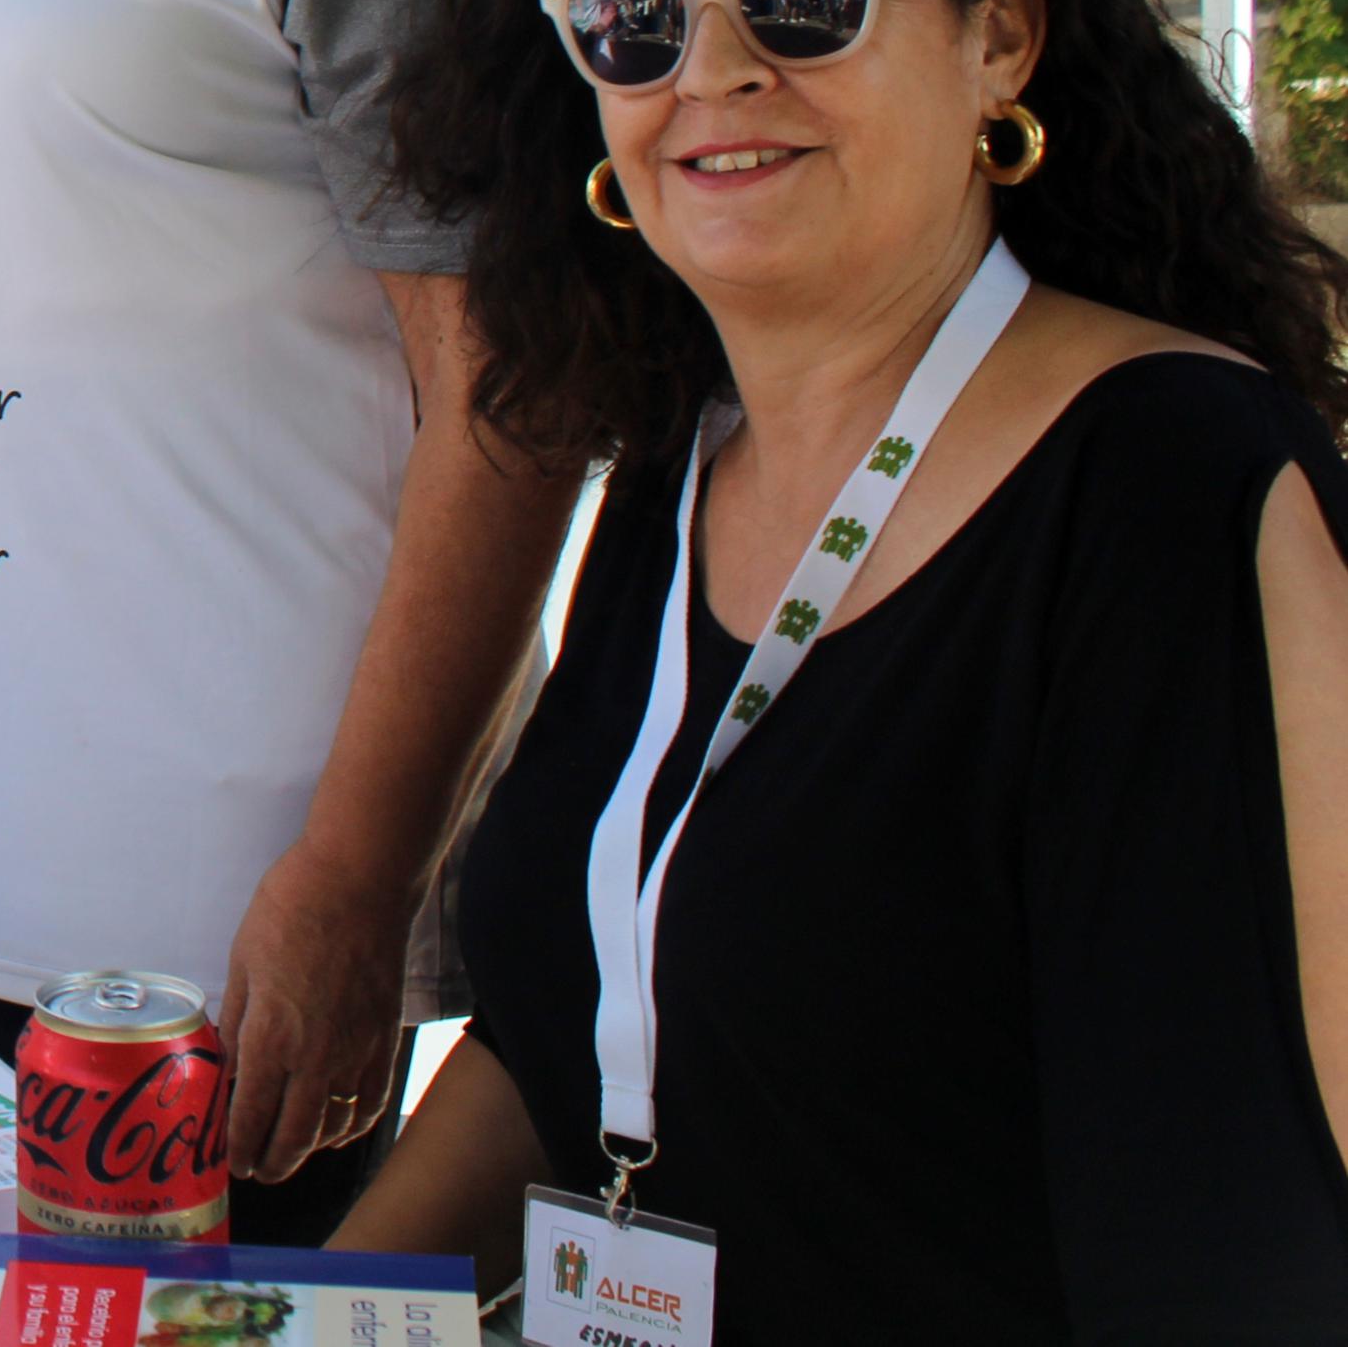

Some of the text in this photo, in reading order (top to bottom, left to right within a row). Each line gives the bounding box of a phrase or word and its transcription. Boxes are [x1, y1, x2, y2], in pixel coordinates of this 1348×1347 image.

[36, 1207, 165, 1236] ZERO CAFEÍNA
[88, 1288, 116, 1337] Recetario
[596, 1276, 682, 1323] ALCER
[596, 1301, 683, 1334] PALENCIA
[20, 1307, 50, 1343] familia
